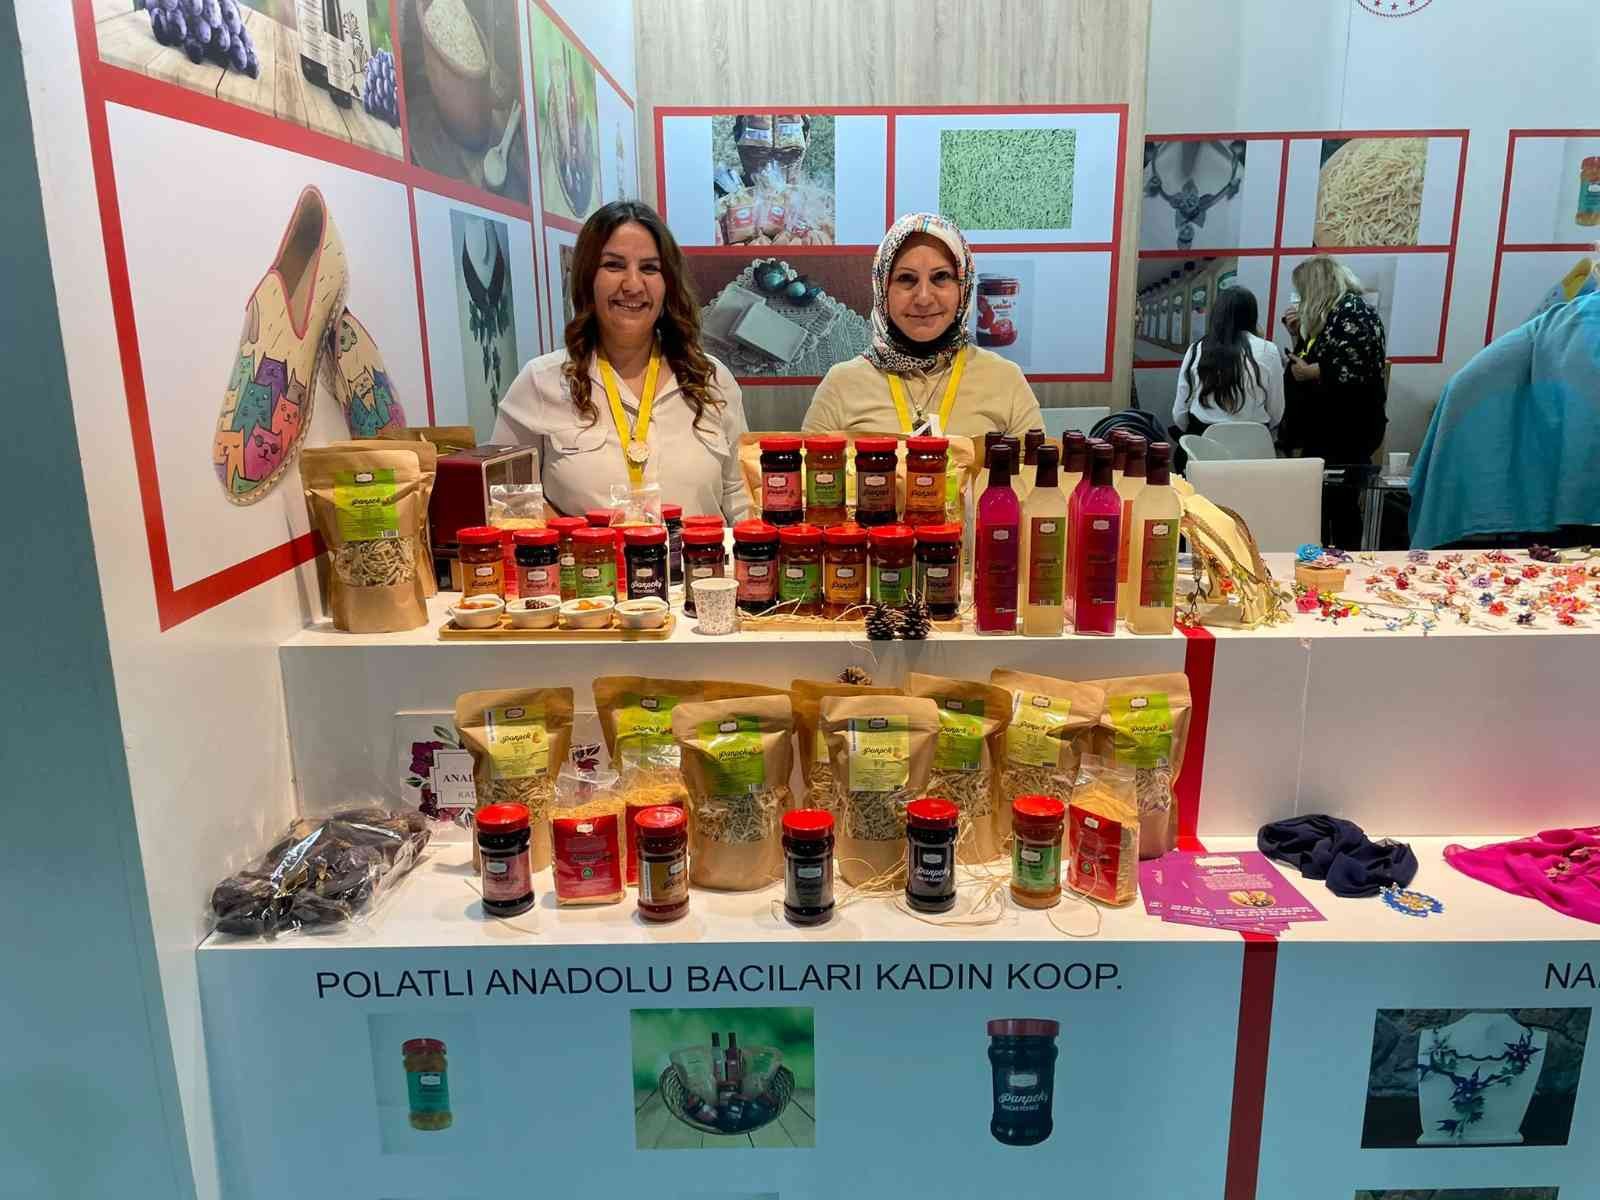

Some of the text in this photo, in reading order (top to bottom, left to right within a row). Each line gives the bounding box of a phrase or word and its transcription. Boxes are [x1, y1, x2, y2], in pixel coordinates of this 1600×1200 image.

[317, 963, 1121, 998] POLATLI ANADOLU BACILARI KADIN KOOP.
[1545, 962, 1600, 989] NA
